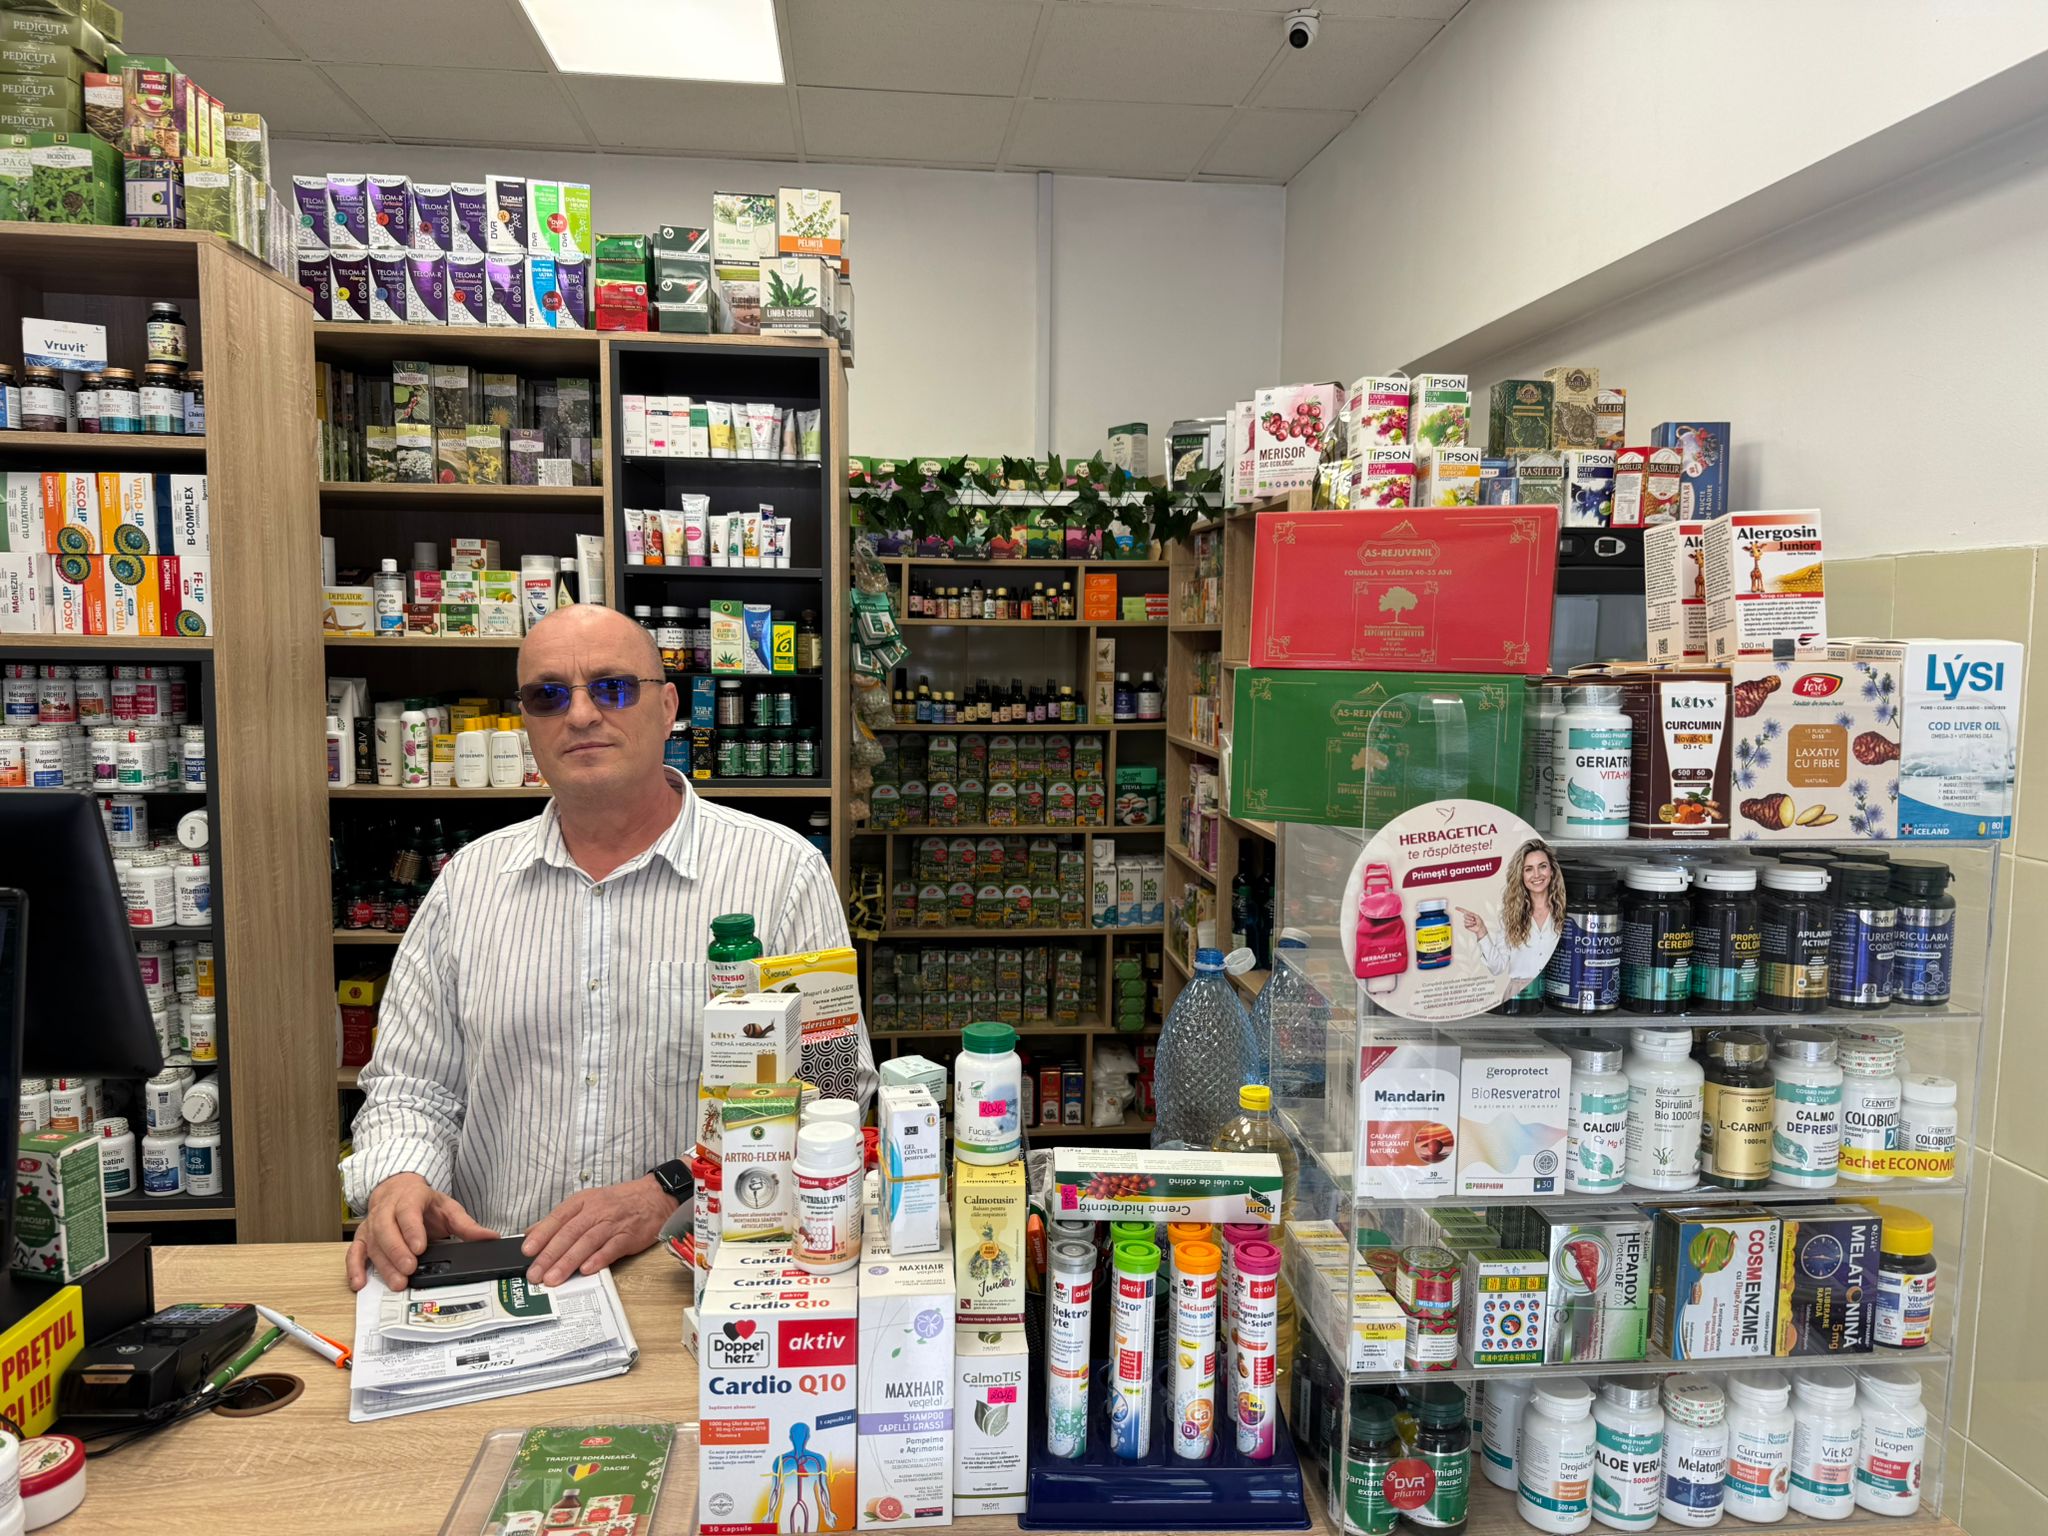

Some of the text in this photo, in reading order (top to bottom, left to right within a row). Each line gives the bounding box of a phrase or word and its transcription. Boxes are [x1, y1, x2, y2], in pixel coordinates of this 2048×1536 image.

[767, 310, 784, 318] LIMBA
[44, 340, 86, 353] Vruvit
[1367, 378, 1408, 393] TIPSON
[1424, 375, 1466, 389] TIPSON
[1260, 447, 1305, 461] MERISOR
[1367, 447, 1411, 462] TIPSON
[1438, 448, 1479, 462] TIPSON
[1577, 452, 1616, 465] TIPSON
[1520, 467, 1563, 477] BASILUR
[1618, 463, 1642, 472] BASILUR
[1650, 463, 1680, 475] BASILUR
[76, 477, 87, 522] ASCOLIP
[185, 487, 196, 545] B-COMPLEX
[1737, 525, 1817, 541] Alergosin
[1777, 541, 1816, 551] Junior
[1364, 548, 1433, 558] AS-REJUVENIL
[1386, 568, 1413, 576] VÂRSTA
[63, 586, 74, 630] ASCOLIP
[1337, 708, 1403, 719] AS-REJUVENIL
[1665, 720, 1722, 731] CURCUMIN
[1928, 722, 2001, 731] COD LIVER OIL
[1795, 748, 1839, 758] LAXATIV
[1794, 759, 1840, 768] CU FIBRE
[1399, 823, 1498, 846] HERBAGETICA
[1914, 827, 1950, 836] ICELAND
[1408, 839, 1493, 859] te răsplătește!
[1412, 862, 1492, 882] Primești garantat!
[1590, 922, 1607, 930] DVR
[1861, 932, 1893, 943] TURKEY
[1361, 951, 1402, 963] HERBAGETICA
[1575, 947, 1605, 955] CIUPERCA
[1864, 986, 1876, 994] 60
[1581, 993, 1592, 1001] 60
[1486, 1066, 1549, 1079] geroprotect
[1375, 1090, 1445, 1103] Mandarin
[1471, 1088, 1560, 1100] BioResveratrol
[1655, 1099, 1692, 1110] Spirulină
[1655, 1110, 1669, 1120] Bio
[1796, 1110, 1835, 1122] CALMO
[968, 1126, 991, 1135] Fucus
[1583, 1122, 1619, 1134] CALCIU
[1378, 1140, 1409, 1148] RELAXANT
[1607, 1139, 1618, 1149] Mg
[724, 1151, 791, 1163] ARTRO-FLEX HA
[904, 1152, 937, 1162] pentru ochi
[1838, 1152, 1886, 1170] Pachet
[1653, 1169, 1665, 1177] 100
[1169, 1178, 1196, 1186] cătină
[1200, 1178, 1211, 1186] de
[1214, 1178, 1231, 1187] ulei
[1472, 1182, 1504, 1190] PARAPHARM
[1541, 1180, 1552, 1188] 30
[963, 1195, 1015, 1206] Calmotusin
[1079, 1203, 1190, 1216] Cremă hidratantă
[1246, 1204, 1276, 1216] plant
[899, 1263, 944, 1272] MAXHAIR
[734, 1277, 831, 1287] Cardio Q10
[978, 1278, 1016, 1298] Junior
[1741, 1229, 1765, 1346] COSMENZIME
[1121, 1284, 1141, 1293] aktiv
[1254, 1284, 1274, 1294] aktiv
[729, 1300, 830, 1310] Cardio Q10
[1121, 1303, 1141, 1312] STOP
[1418, 1301, 1432, 1309] WILD
[1816, 1287, 1824, 1319] RAPIDĂ
[1823, 1287, 1832, 1329] ELIBERARE
[714, 1339, 764, 1353] Doppel
[789, 1332, 845, 1350] aktiv
[2, 1310, 76, 1393] PREȚUL
[725, 1352, 755, 1364] herz
[963, 1370, 1021, 1384] CalmoTIS
[709, 1373, 846, 1396] Cardio Q10
[885, 1381, 944, 1399] MAXHAIR
[908, 1397, 942, 1409] vegetal
[904, 1411, 944, 1421] SHAMPOO
[1190, 1408, 1209, 1420] Ca
[879, 1421, 944, 1433] CAPELLI GRASSI
[906, 1436, 944, 1446] Pompelmo
[1875, 1437, 1913, 1452] Licopen
[906, 1445, 944, 1455] Agrimonia
[1694, 1447, 1720, 1457] ZENYTH
[1737, 1445, 1783, 1459] Curcumin
[1822, 1446, 1838, 1458] Vit
[1560, 1461, 1588, 1473] Drojdie
[1595, 1450, 1661, 1474] ALOE VERA
[1560, 1471, 1578, 1480] bere
[1395, 1476, 1425, 1488] DVR
[1438, 1477, 1463, 1487] extract
[1393, 1488, 1426, 1500] pharm
